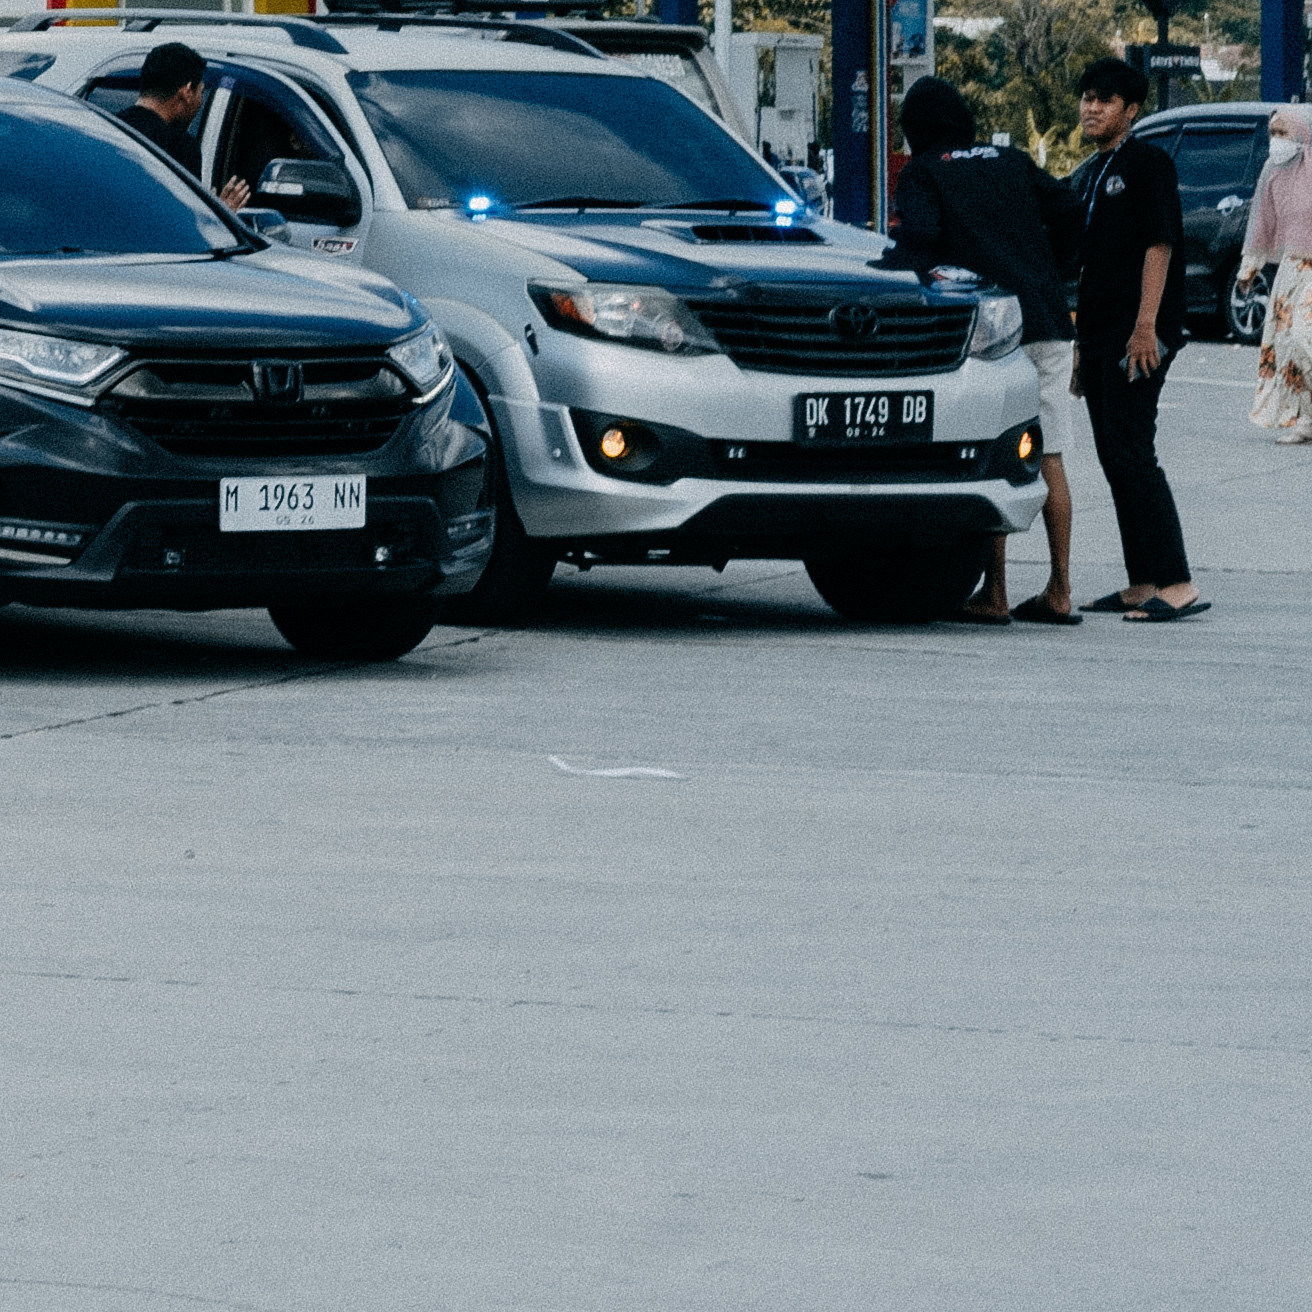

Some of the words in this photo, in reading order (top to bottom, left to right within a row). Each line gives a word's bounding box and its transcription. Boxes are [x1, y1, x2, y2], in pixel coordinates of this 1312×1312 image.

[806, 397, 830, 426] DK
[844, 396, 889, 426] 1749
[902, 395, 927, 424] DB
[225, 484, 239, 512] M
[258, 483, 314, 511] 1963
[334, 481, 361, 509] NN
